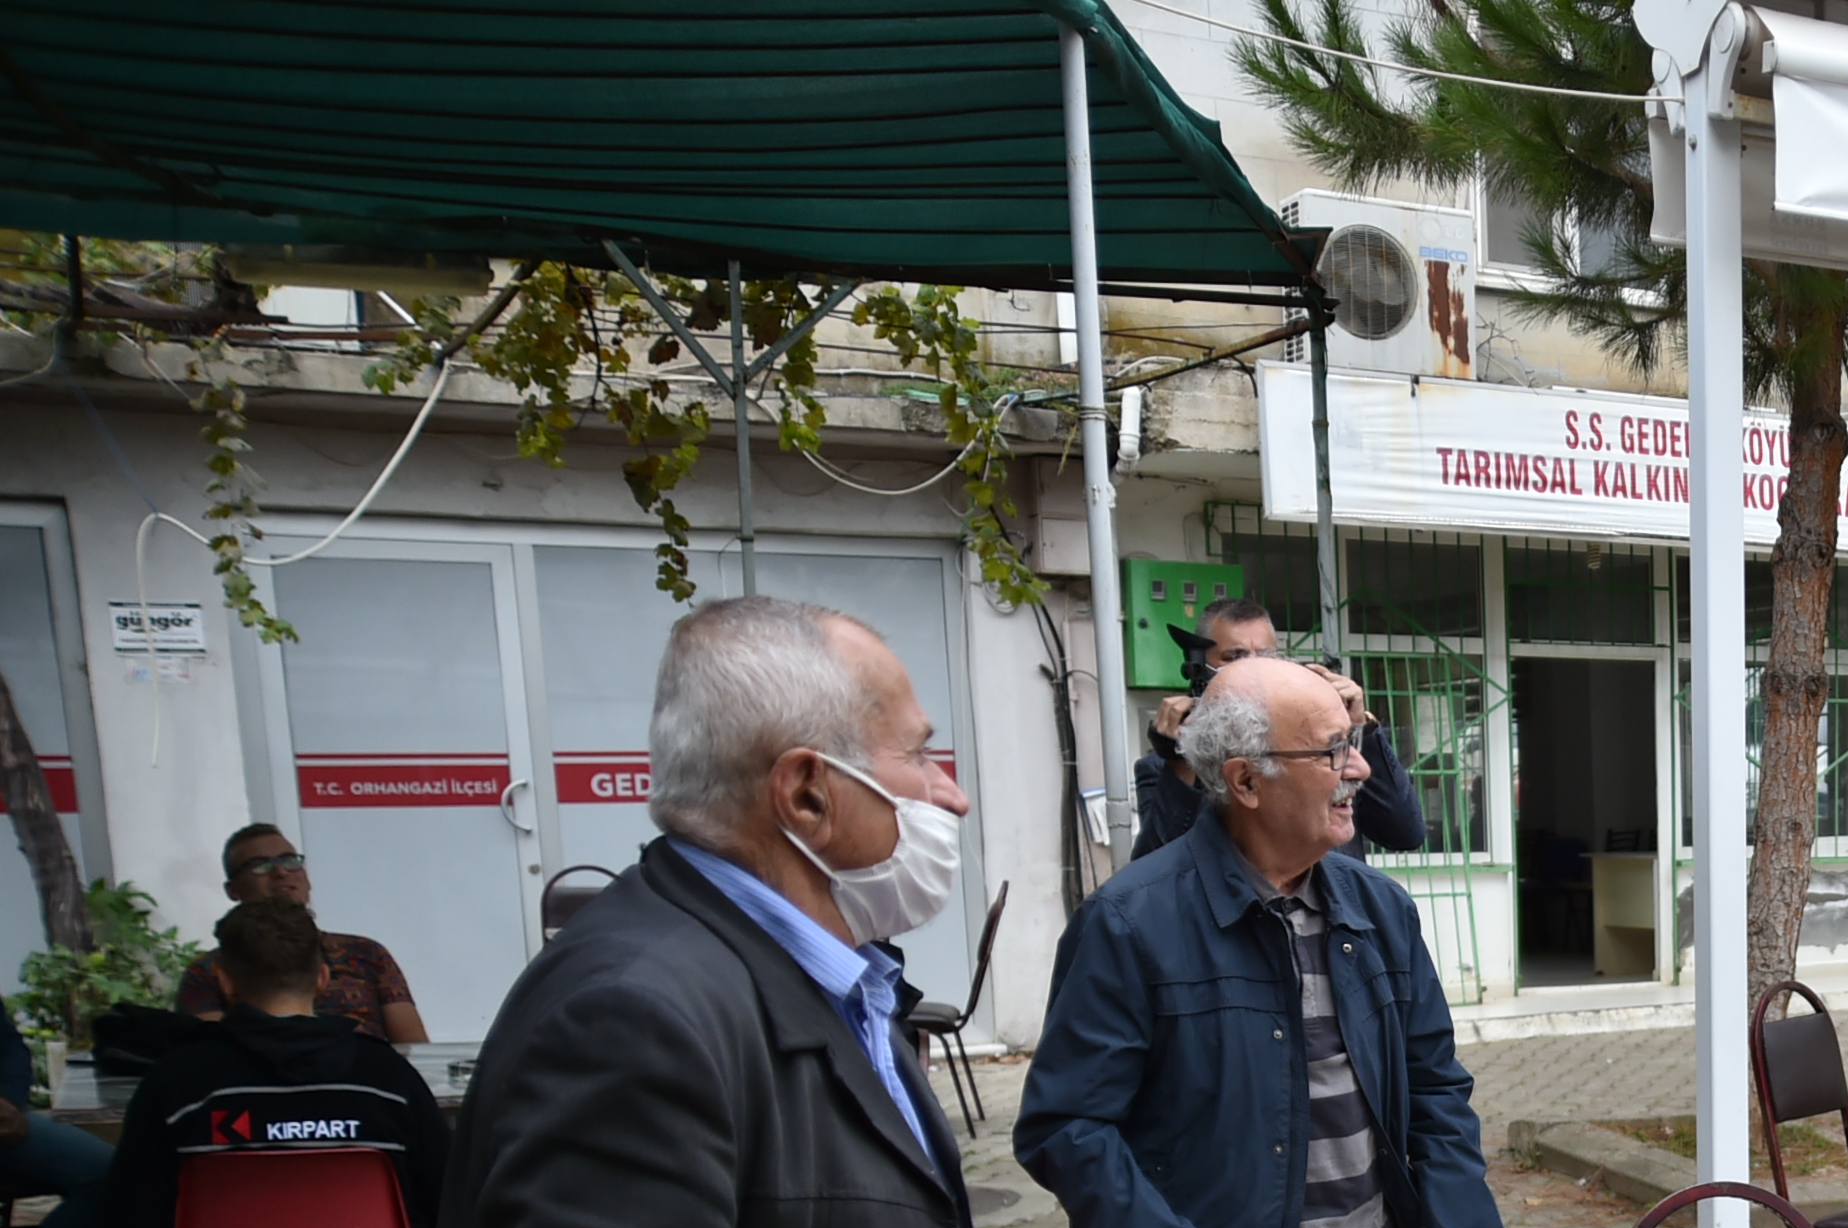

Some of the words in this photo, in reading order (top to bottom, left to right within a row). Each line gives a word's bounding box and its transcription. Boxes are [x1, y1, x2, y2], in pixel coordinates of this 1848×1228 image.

[1565, 409, 1611, 452] S.S.
[1620, 415, 1690, 458] GEDE
[1436, 447, 1583, 496] TARIMSAL
[1593, 460, 1690, 503] KALKIN
[313, 781, 345, 796] T.C.
[350, 778, 447, 796] ORHANGAZİ
[451, 777, 498, 797] İLÇESİ
[590, 772, 652, 797] GED
[266, 1119, 361, 1140] KIRPART
